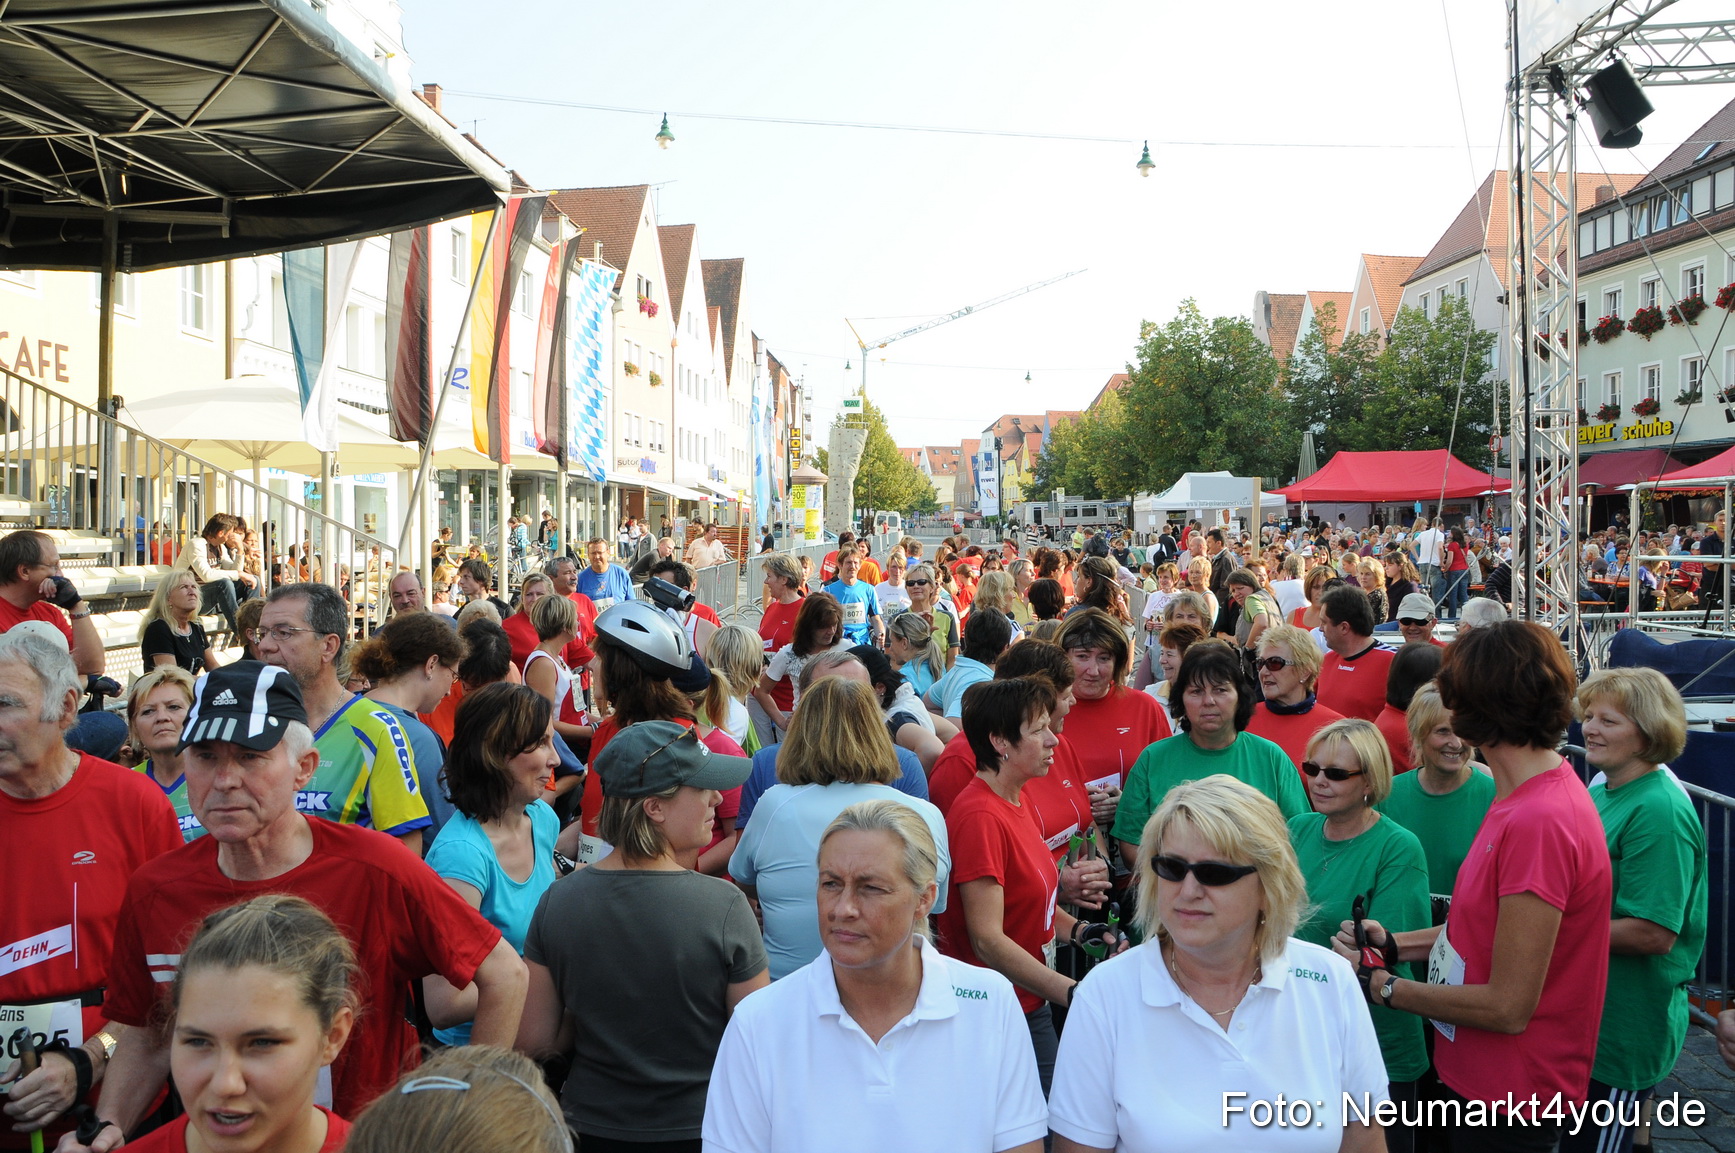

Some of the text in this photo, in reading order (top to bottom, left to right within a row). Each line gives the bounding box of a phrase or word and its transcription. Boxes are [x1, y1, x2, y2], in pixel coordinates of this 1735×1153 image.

[1622, 417, 1674, 441] schuhe
[846, 610, 863, 618] 8077
[1337, 664, 1356, 672] hummel
[212, 698, 238, 706] adidas
[12, 940, 50, 963] DEHN
[1295, 968, 1329, 984] DEKRA
[955, 987, 989, 1001] DEKRA
